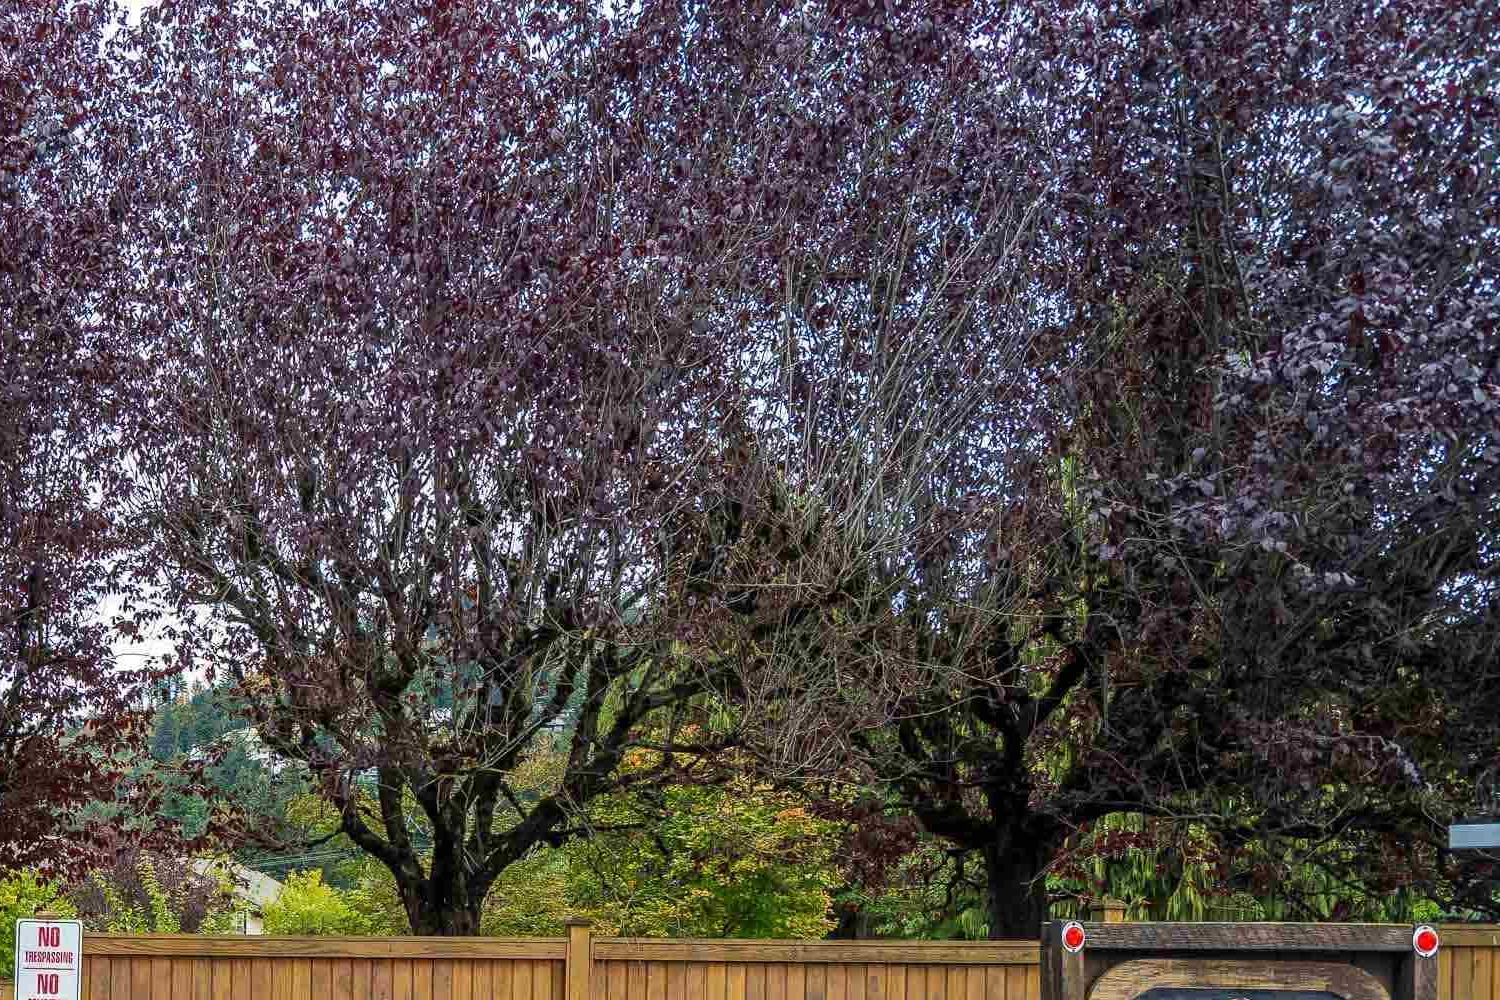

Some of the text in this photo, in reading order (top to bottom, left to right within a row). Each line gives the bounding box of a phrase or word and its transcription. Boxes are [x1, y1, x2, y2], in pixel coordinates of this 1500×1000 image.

[38, 926, 60, 947] NO
[25, 951, 73, 964] TRESPASSING
[37, 974, 59, 994] NO
